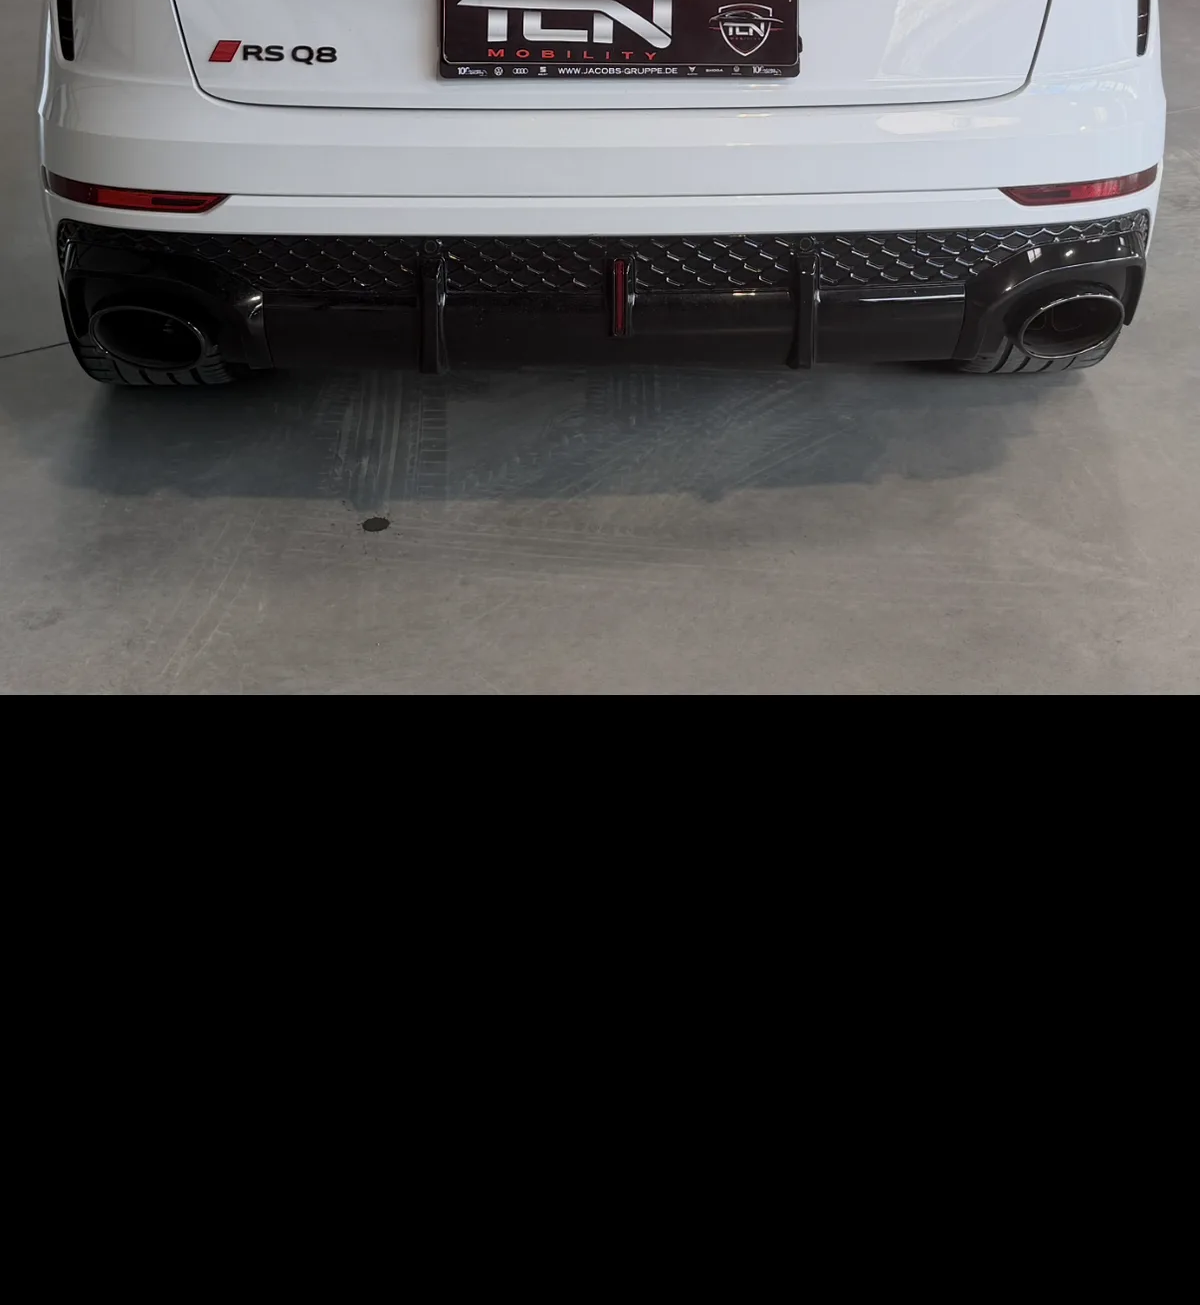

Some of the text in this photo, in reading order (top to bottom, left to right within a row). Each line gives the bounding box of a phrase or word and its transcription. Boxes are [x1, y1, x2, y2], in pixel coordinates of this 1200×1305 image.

[242, 44, 338, 65] RS Q8
[487, 48, 657, 61] MOBILITY
[557, 67, 678, 75] WWW.JACOBS-GRUPPE.DE
